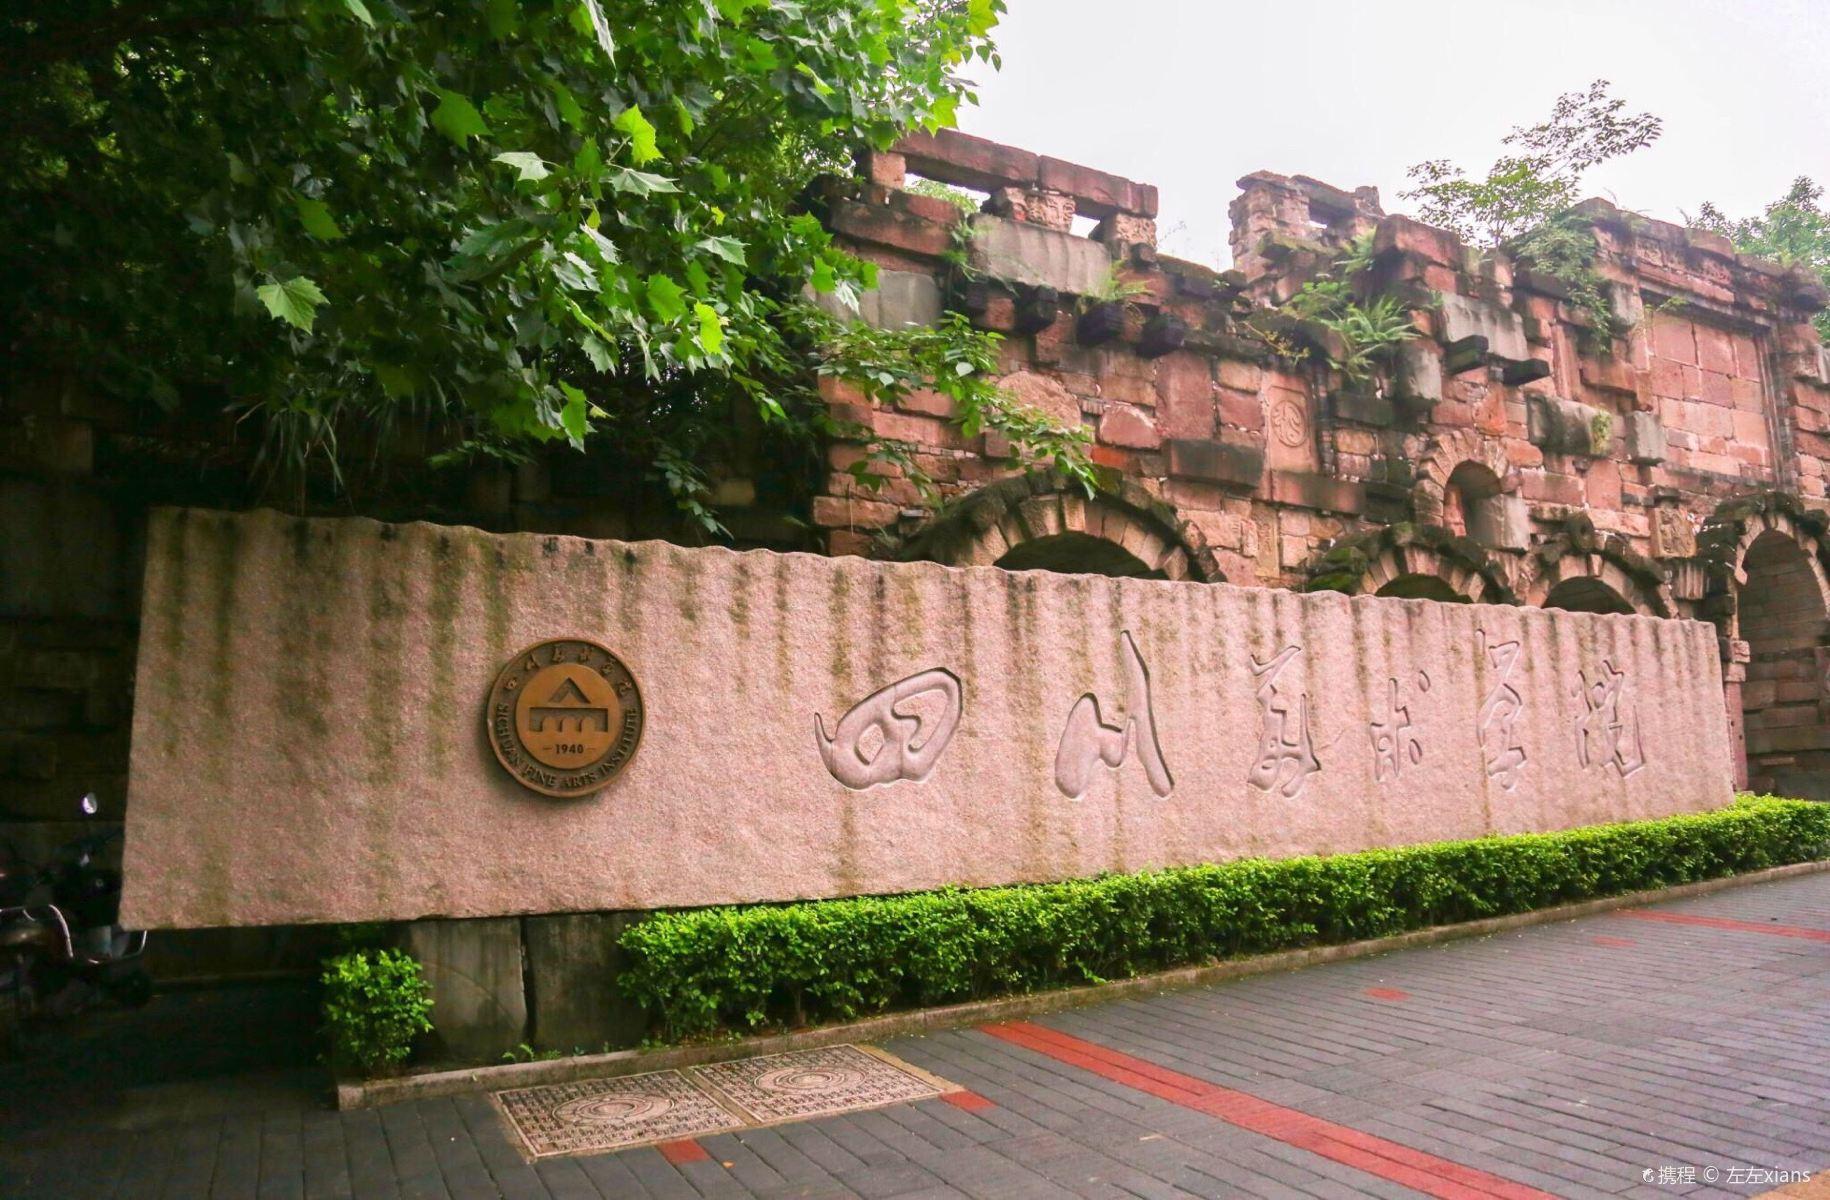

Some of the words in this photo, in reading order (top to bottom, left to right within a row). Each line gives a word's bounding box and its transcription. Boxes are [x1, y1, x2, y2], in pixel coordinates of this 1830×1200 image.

[496, 703, 520, 768] SICHUAN
[522, 768, 556, 786] FINE
[556, 744, 584, 754] 1940
